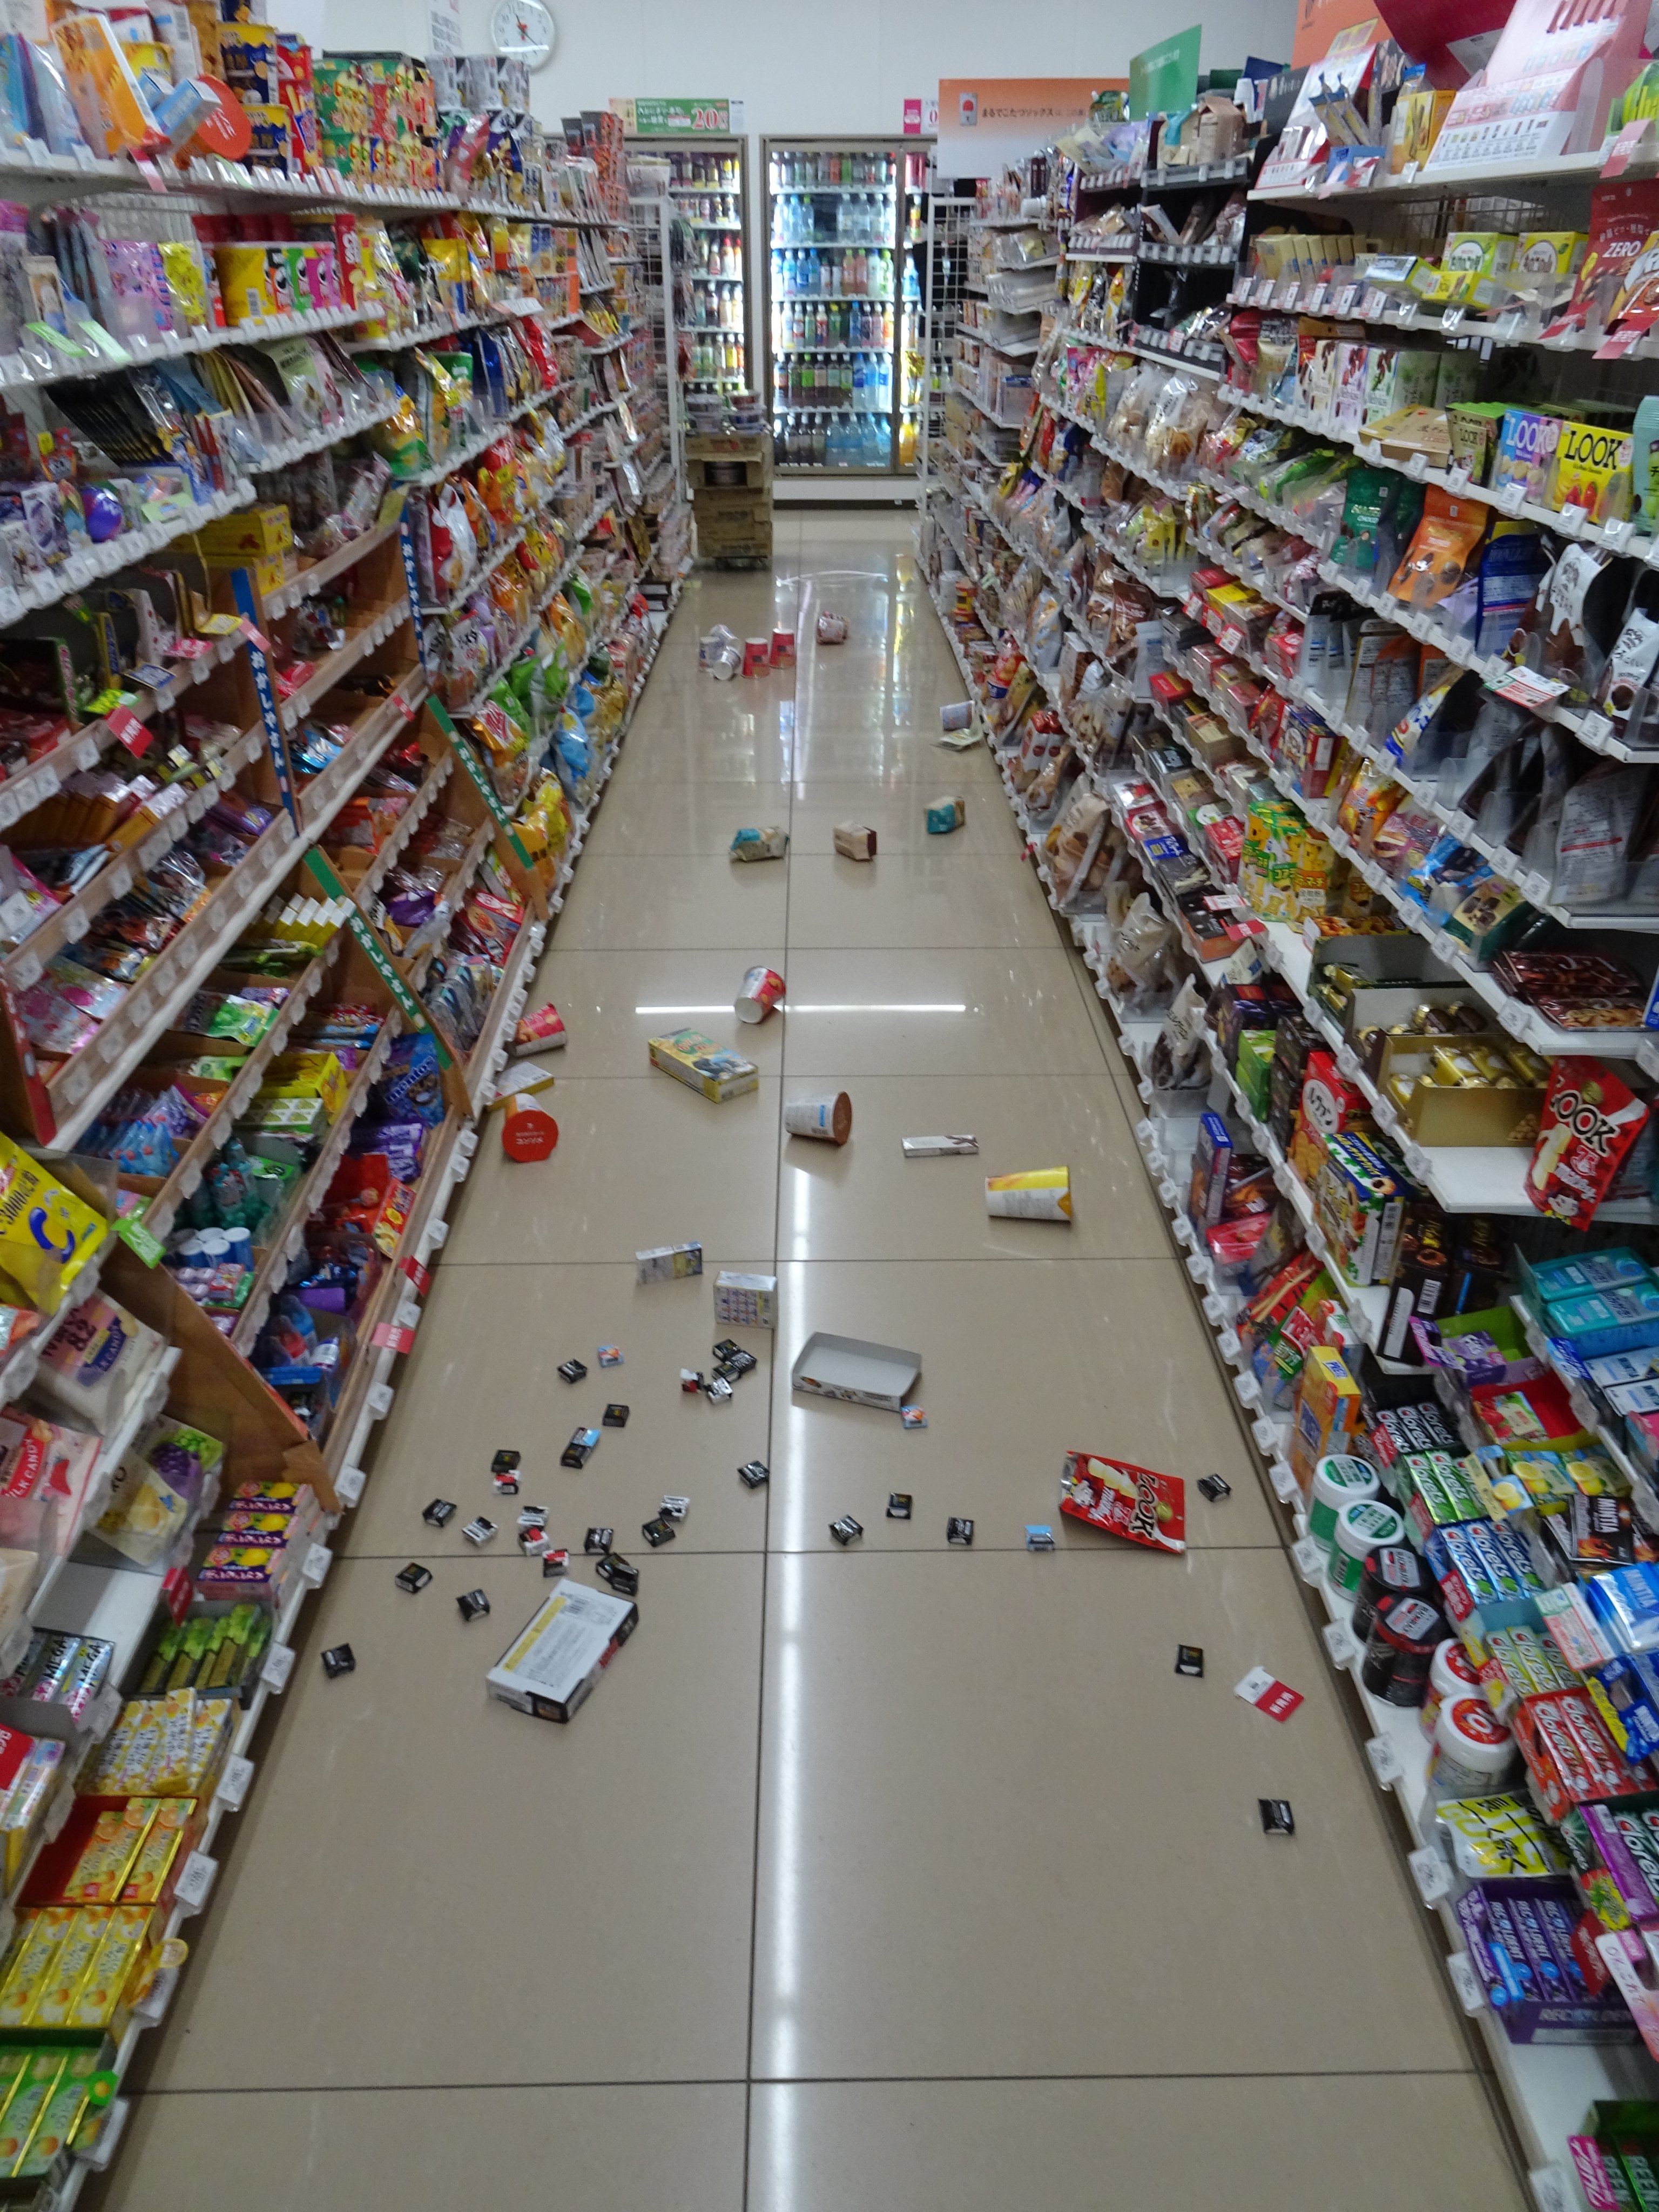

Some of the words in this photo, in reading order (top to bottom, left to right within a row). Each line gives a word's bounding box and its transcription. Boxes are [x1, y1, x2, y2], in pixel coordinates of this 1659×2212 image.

[1602, 241, 1641, 258] ZERO
[1563, 430, 1623, 471] LOOK
[385, 1057, 436, 1105] mentos
[1396, 1405, 1434, 1450] Clorets
[1408, 1456, 1448, 1505] Clorets
[1431, 1452, 1470, 1500] Clorets
[1128, 1471, 1159, 1541] LOOK
[1441, 1527, 1487, 1581] Clorets
[1466, 1521, 1512, 1577] Clorets
[44, 1638, 68, 1682] MEGA
[1509, 1627, 1557, 1694] Clorets
[1535, 1701, 1574, 1761] Clorets
[1562, 1696, 1604, 1755] Clorets
